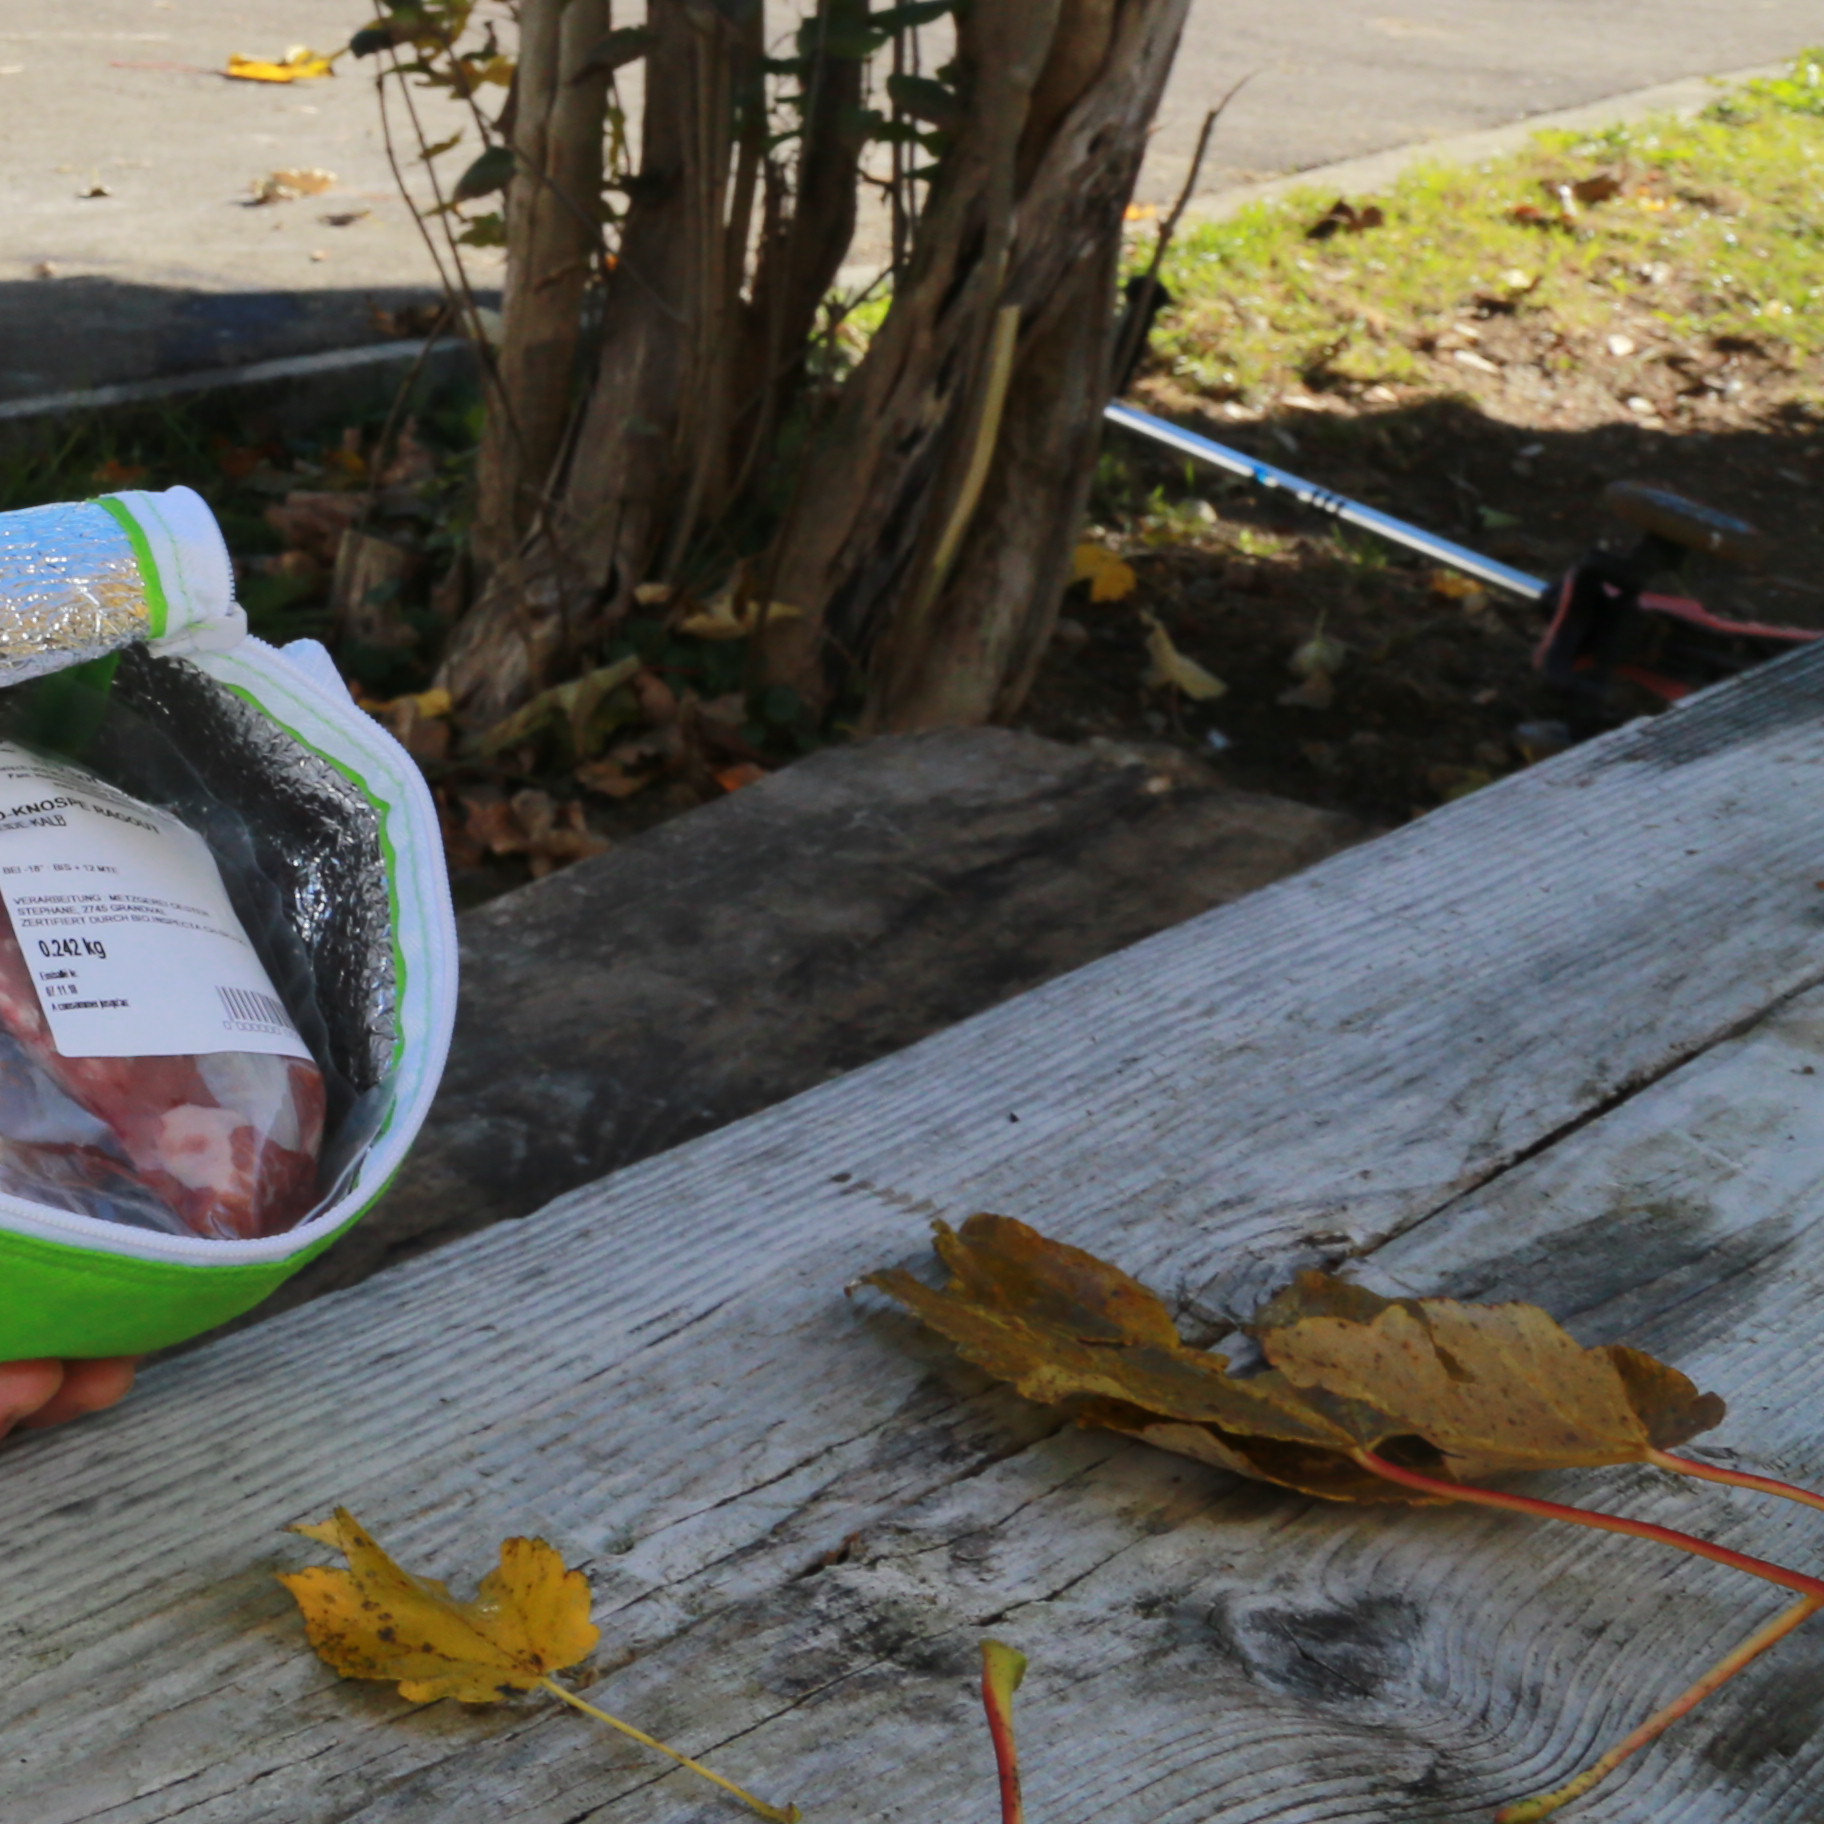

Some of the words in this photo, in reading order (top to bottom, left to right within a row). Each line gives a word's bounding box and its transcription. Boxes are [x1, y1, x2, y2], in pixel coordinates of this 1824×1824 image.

[52, 863, 72, 872] BIS
[82, 863, 94, 872] 12
[37, 938, 82, 958] 0.242
[81, 936, 107, 960] kg
